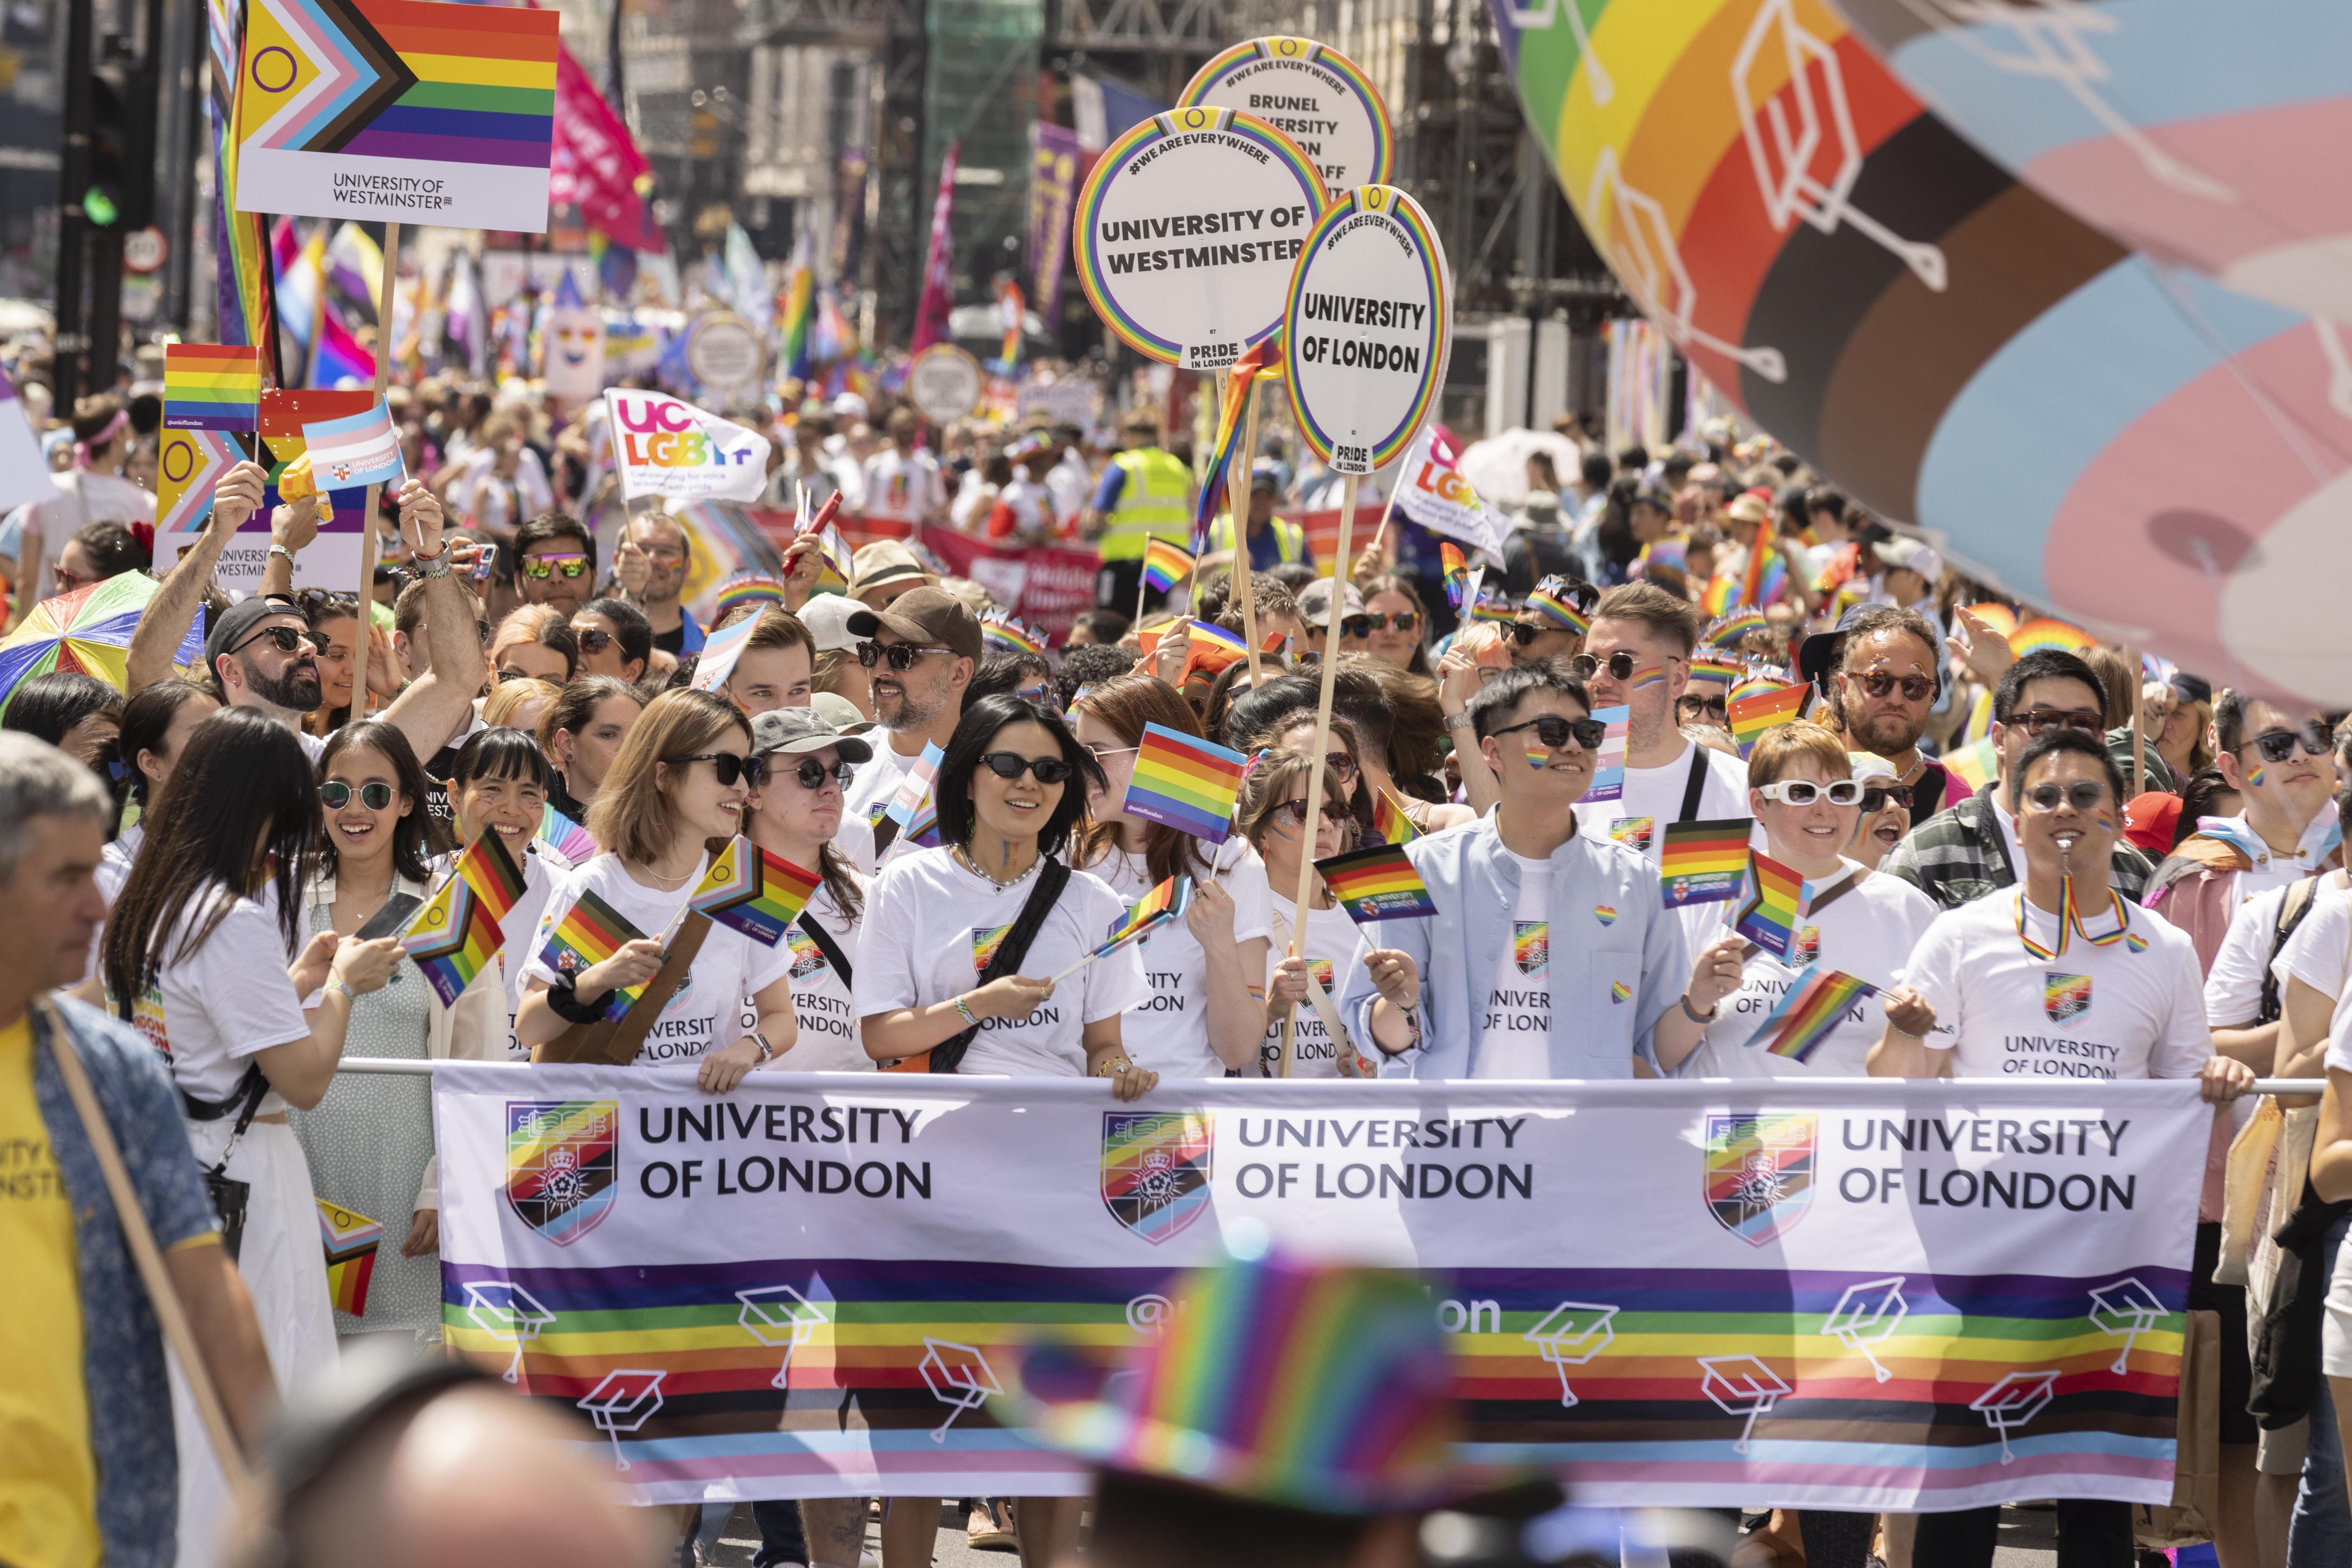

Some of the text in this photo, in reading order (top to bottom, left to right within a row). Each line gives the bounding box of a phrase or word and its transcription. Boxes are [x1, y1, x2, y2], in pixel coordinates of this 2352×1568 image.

[1249, 94, 1319, 112] BRUNEL
[334, 173, 444, 193] UNIVERSITY OF
[333, 189, 442, 209] WESTMINSTER
[1102, 206, 1306, 242] UNIVERSITY OF
[1107, 238, 1306, 274] WESTMINSTER
[1304, 293, 1426, 330] UNIVERSITY
[1203, 357, 1239, 367] LONDON
[1303, 335, 1420, 374] OF LONDON
[352, 450, 393, 468] UNIVERSITY
[365, 456, 396, 473] LONDON
[1336, 461, 1366, 473] IN LONDON
[218, 549, 267, 562] UNIVERSI
[1128, 805, 1163, 819] @unioflondon
[755, 922, 777, 935] UNIVERSITY
[1736, 998, 1762, 1013] OF
[2005, 1036, 2121, 1062] UNIVERSITY
[2003, 1059, 2029, 1073] OF
[640, 1102, 923, 1144] UNIVERSITY
[1238, 1118, 1527, 1149] UNIVERSITY
[1842, 1119, 2131, 1157] UNIVERSITY
[640, 1155, 932, 1200] OF LONDON
[1236, 1163, 1533, 1200] OF LONDON
[1838, 1166, 2136, 1212] OF LONDON
